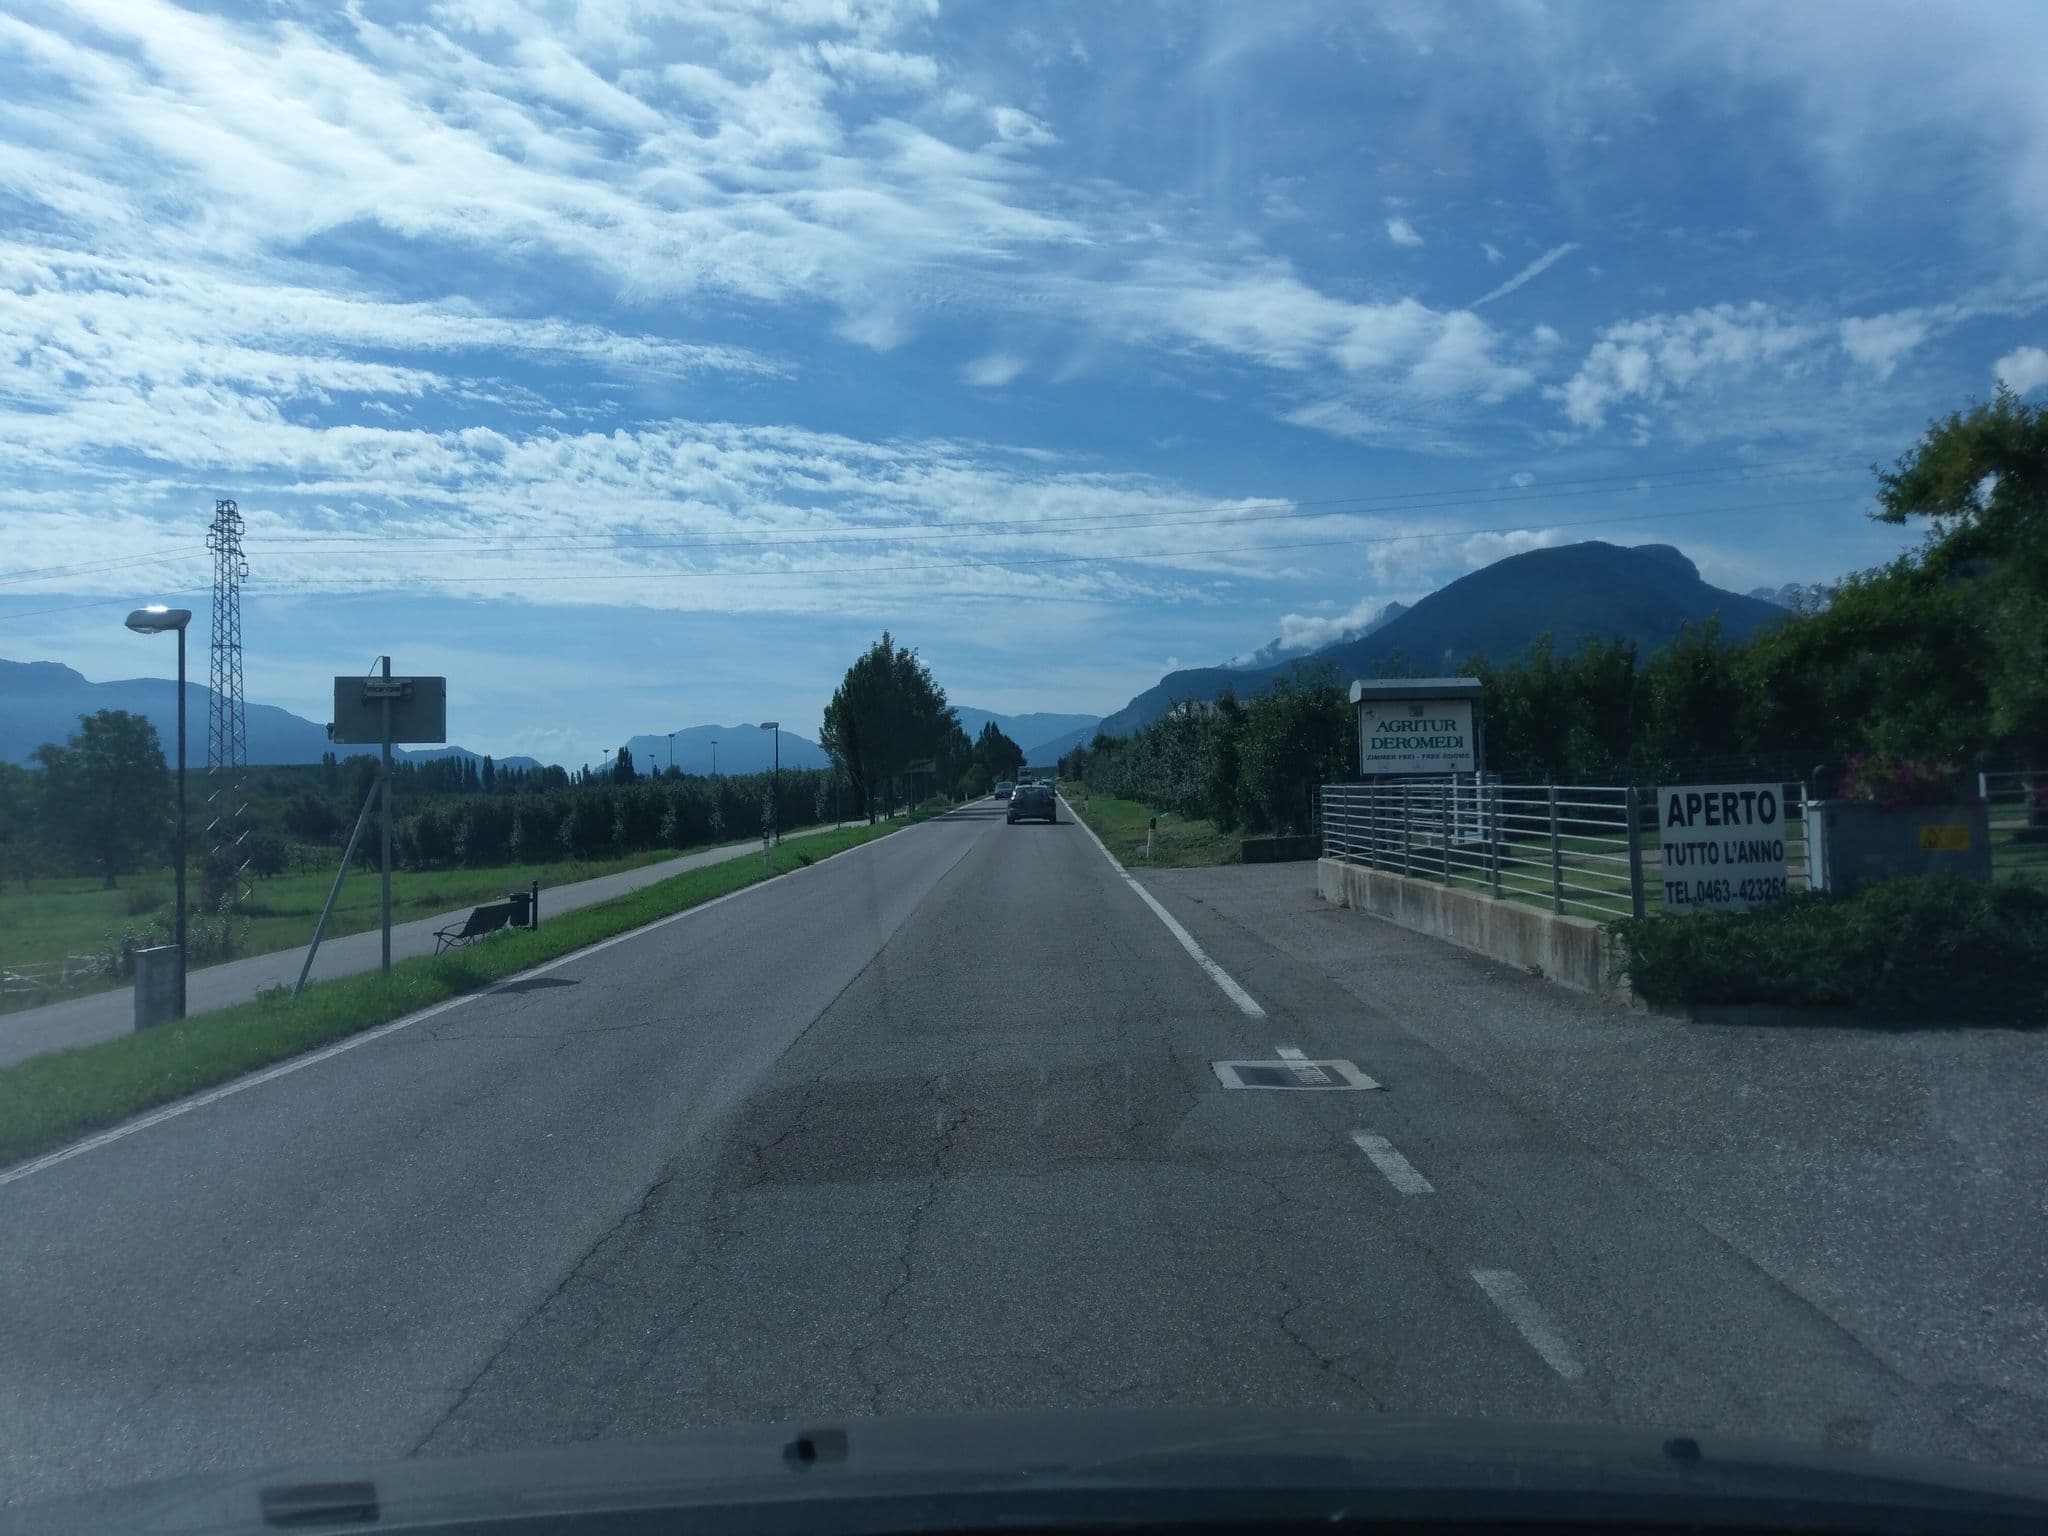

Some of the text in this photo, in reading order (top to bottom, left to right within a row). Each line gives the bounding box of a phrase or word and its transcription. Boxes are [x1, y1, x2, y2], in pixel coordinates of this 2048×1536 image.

[1376, 719, 1457, 733] AGRITUR
[1370, 736, 1464, 750] DEROMEDI
[1667, 791, 1777, 828] APERTO
[1664, 840, 1784, 867] TUTTO L'ANNO
